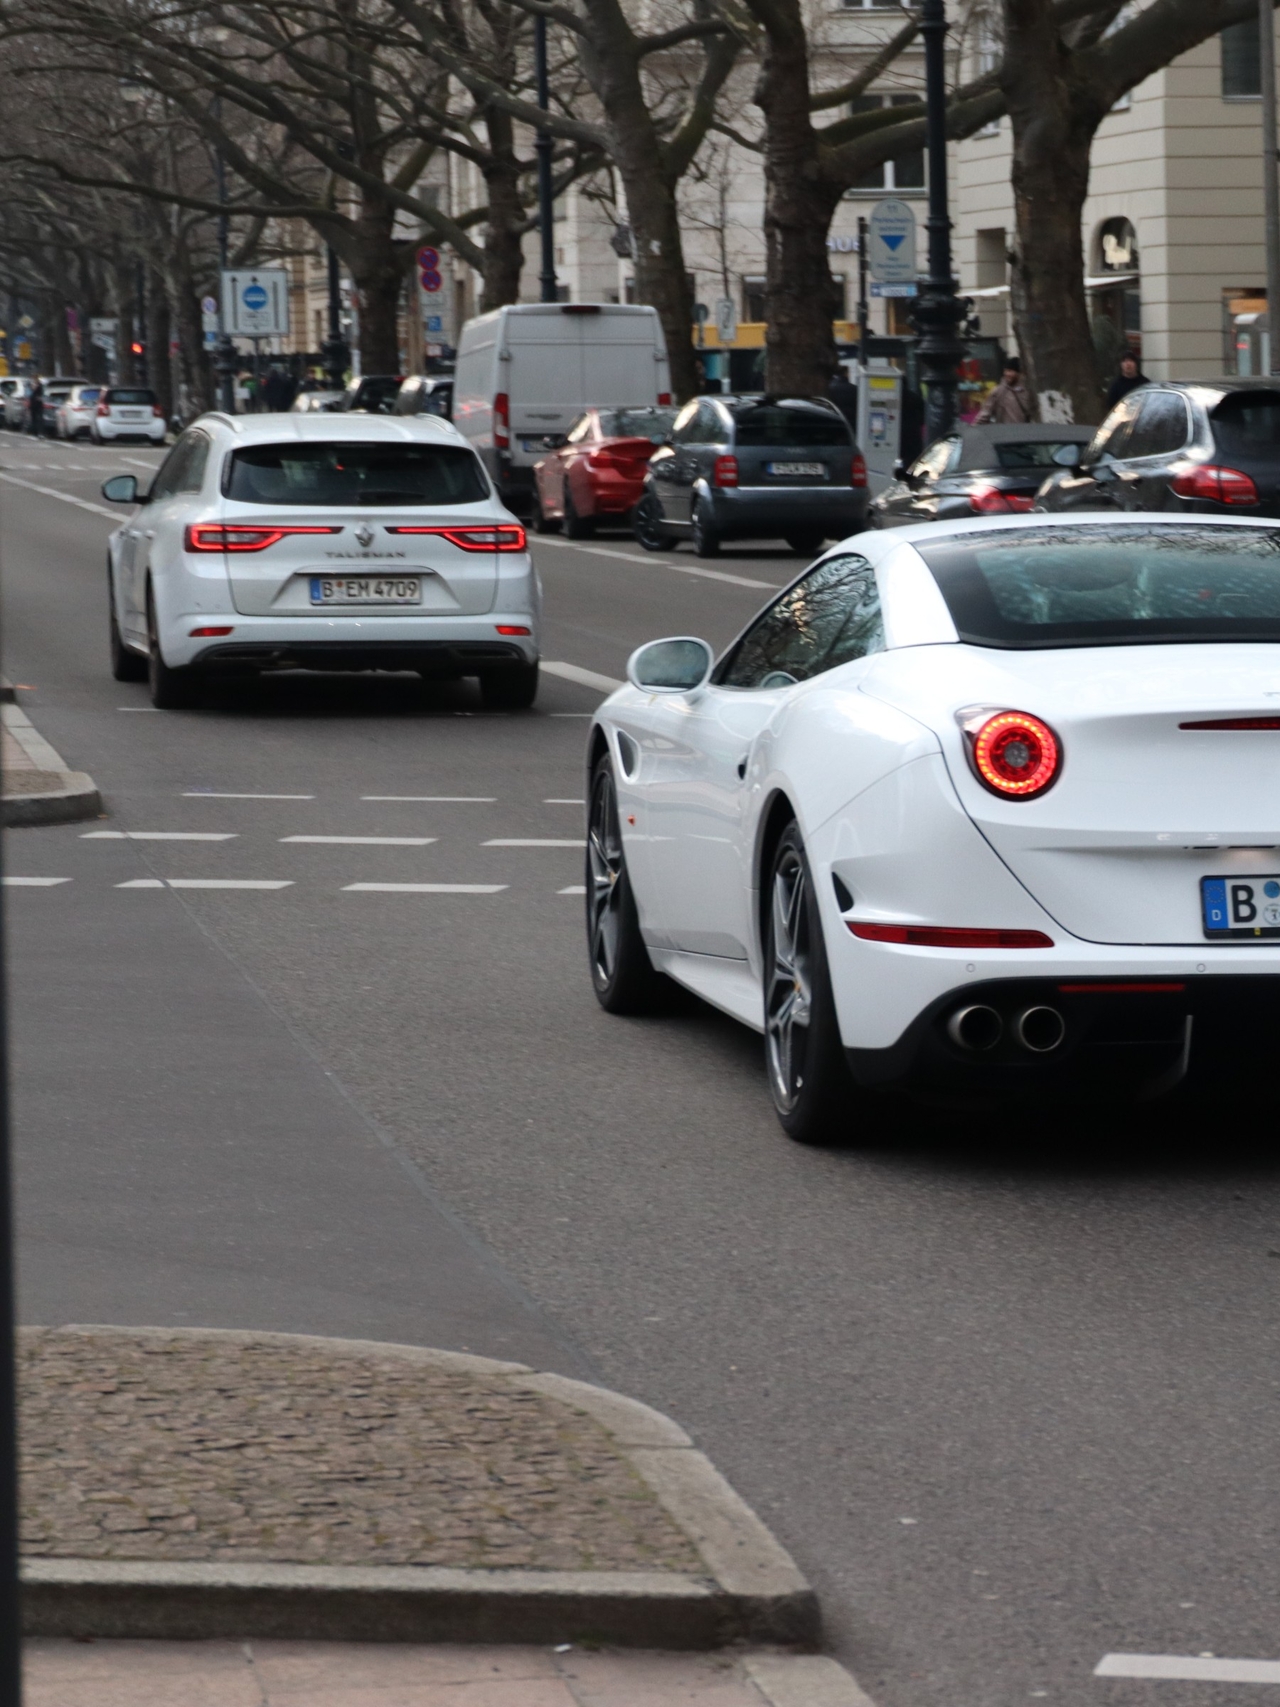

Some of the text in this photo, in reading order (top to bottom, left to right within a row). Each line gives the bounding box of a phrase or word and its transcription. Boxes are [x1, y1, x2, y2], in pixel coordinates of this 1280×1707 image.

[323, 581, 418, 598] B EM 4709
[1231, 884, 1257, 924] B
[1211, 909, 1222, 921] D
